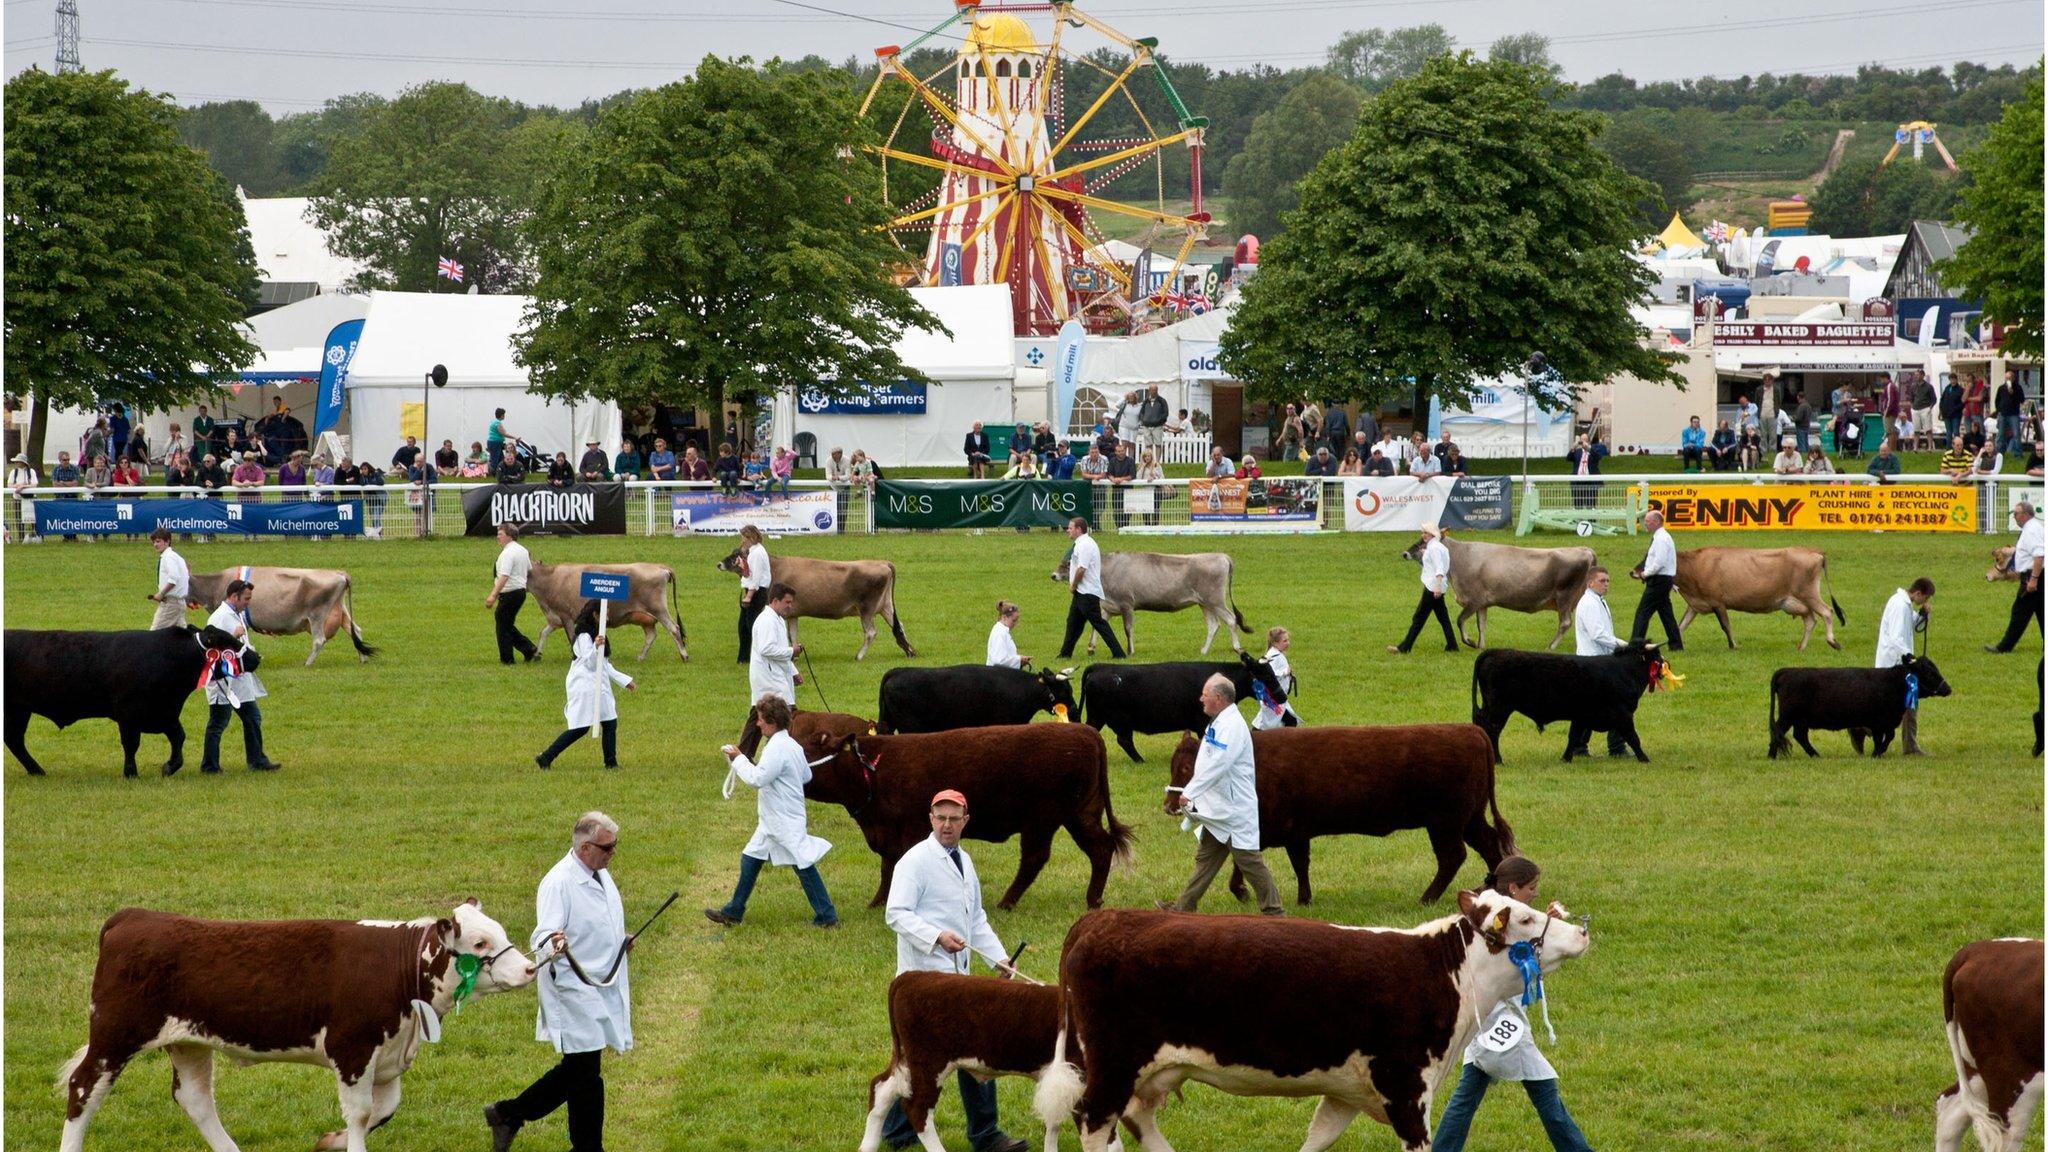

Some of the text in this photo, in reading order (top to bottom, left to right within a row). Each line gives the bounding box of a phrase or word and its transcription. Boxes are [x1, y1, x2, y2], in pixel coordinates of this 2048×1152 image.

[1714, 325, 1892, 337] ESHLY BAKED BAGUETTES
[1064, 344, 1078, 384] old mill
[1188, 356, 1216, 371] old
[834, 394, 870, 407] oung
[1471, 393, 1495, 404] mill
[1637, 488, 1698, 498] Sonsored By
[1809, 490, 1958, 500] PLANT HIRE DEMOLITION
[889, 494, 933, 514] M&S
[961, 493, 1005, 513] M&S
[1032, 492, 1076, 512] M&S
[1818, 501, 1949, 510] CRUSHING & RECYCLING
[491, 490, 594, 528] BLACKTHORN
[46, 519, 118, 530] Michelmores
[156, 517, 228, 529] Michelmores
[268, 519, 339, 530] Michelmores
[1819, 513, 1948, 526] TEL 01761 241387
[1580, 522, 1590, 536] 7
[589, 578, 620, 587] ABERDEEN
[593, 585, 615, 593] ANGUS
[1489, 1020, 1518, 1046] 188
